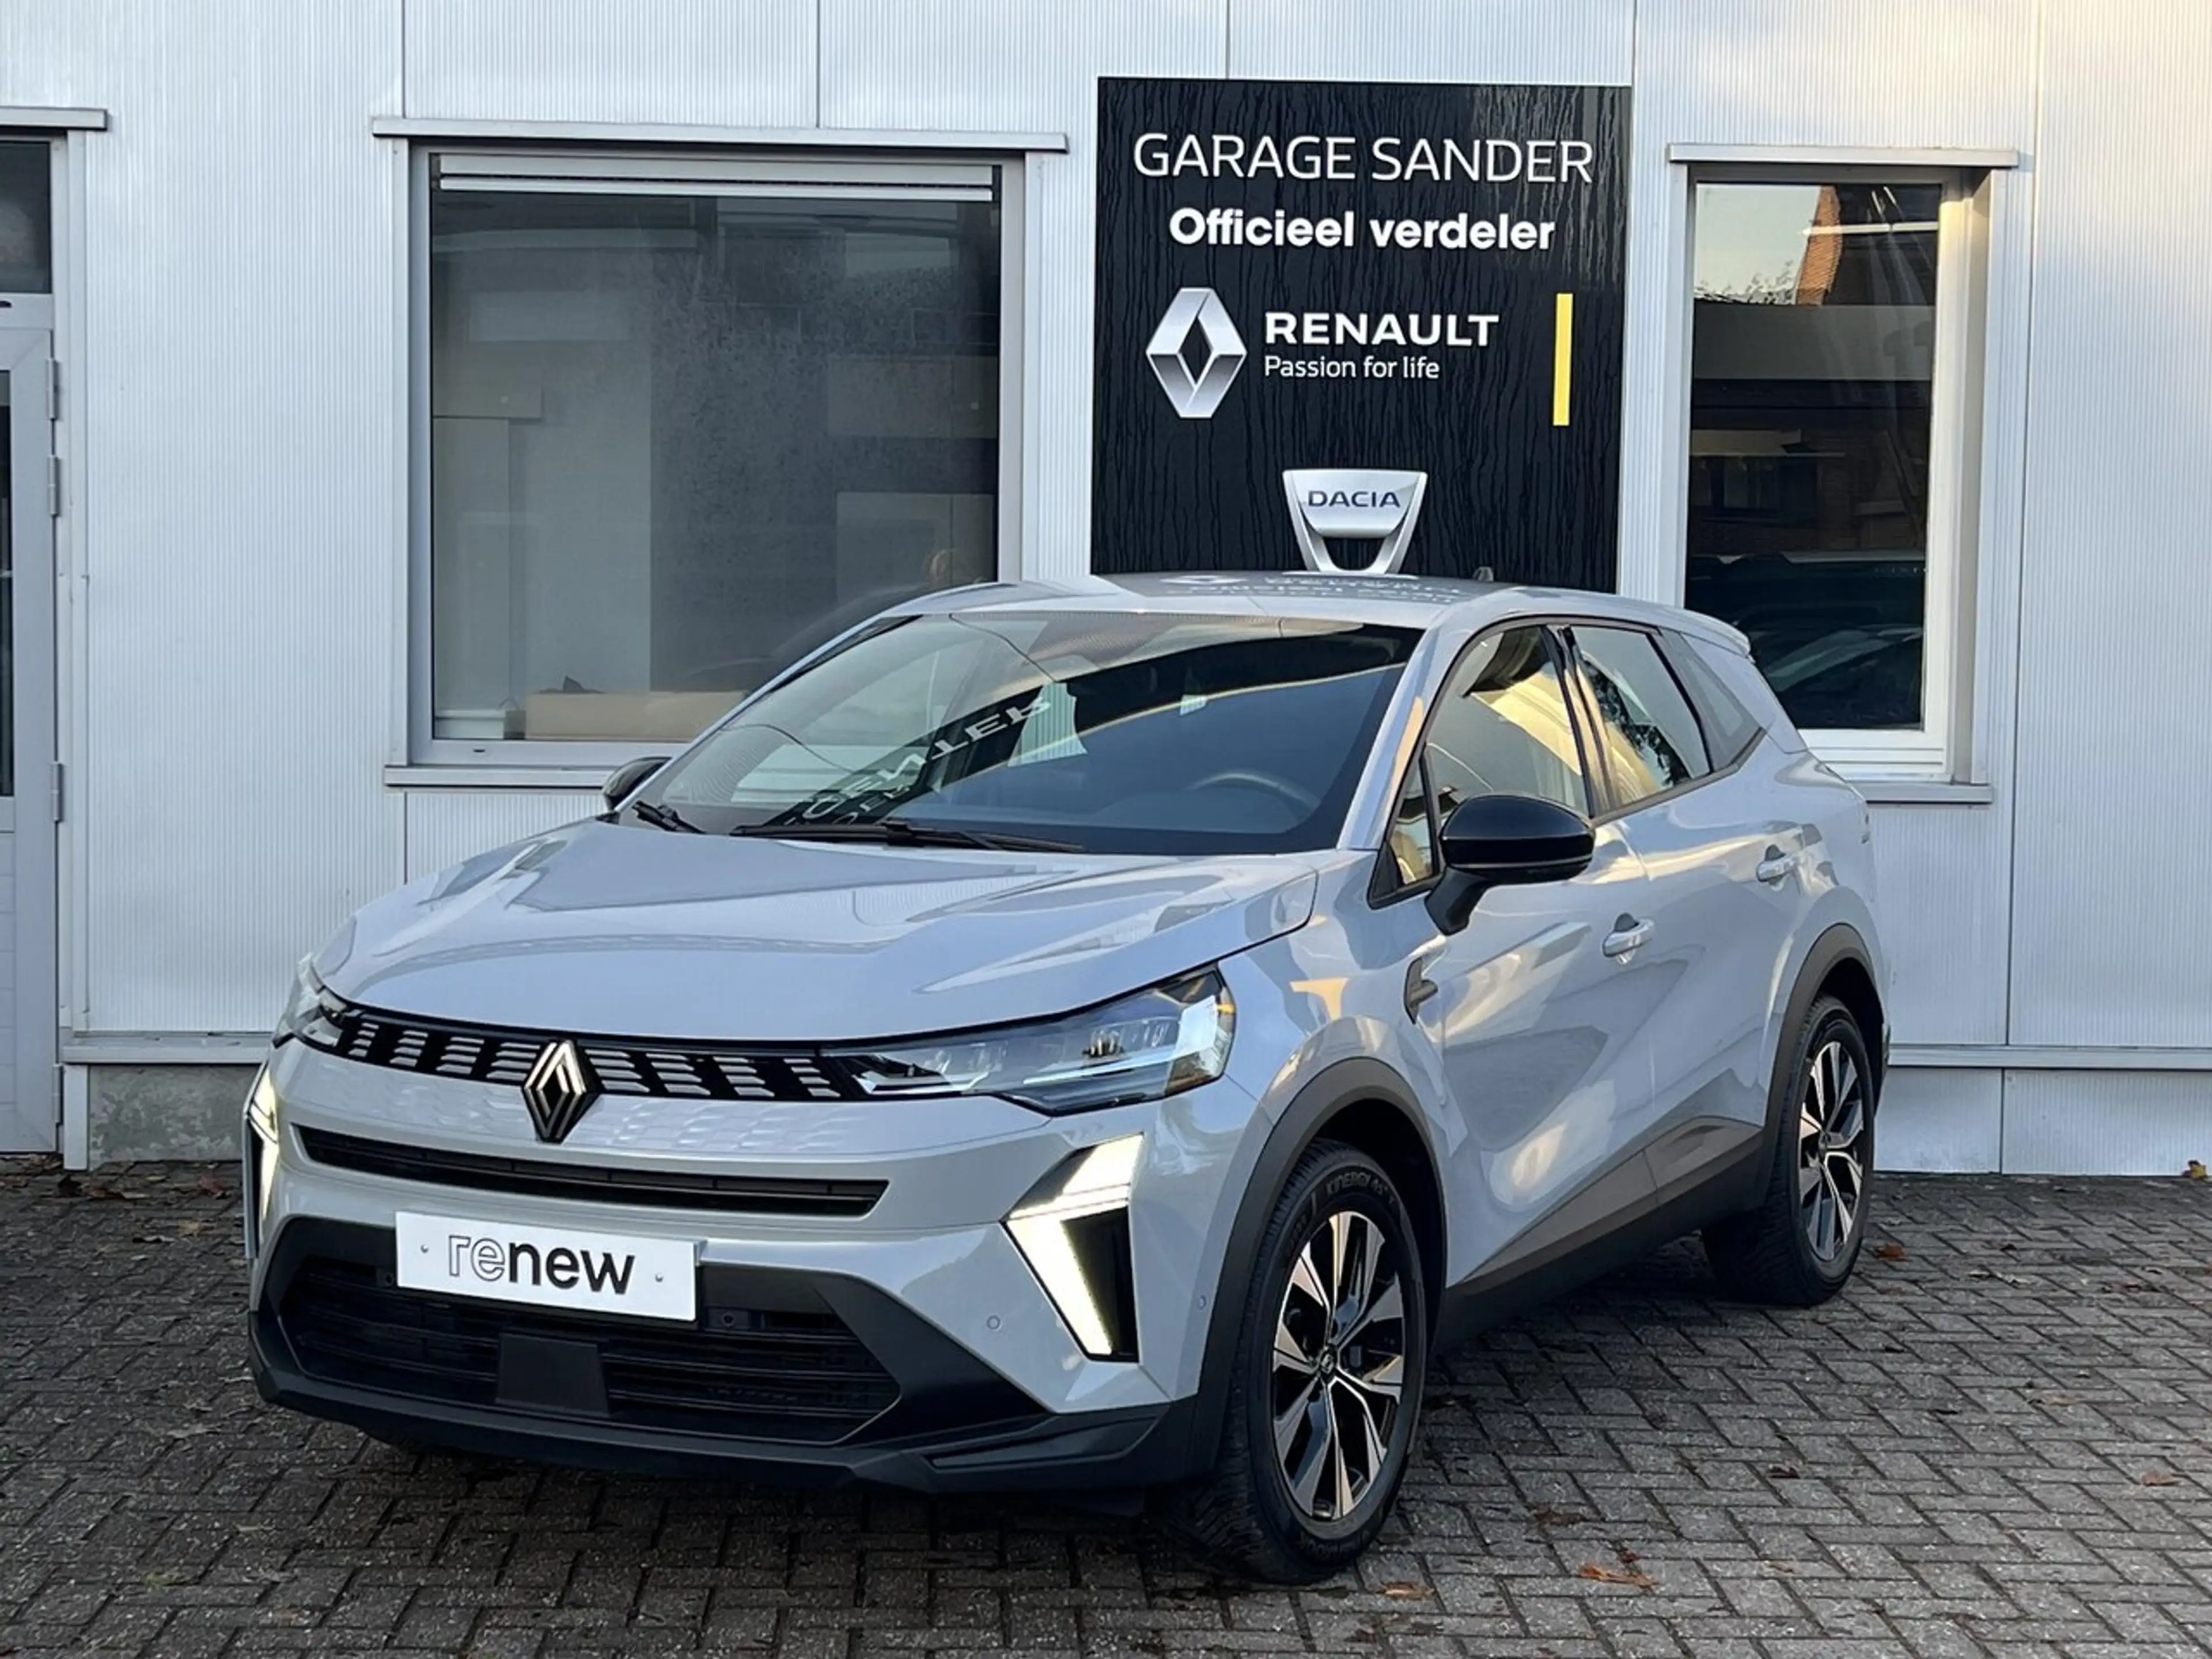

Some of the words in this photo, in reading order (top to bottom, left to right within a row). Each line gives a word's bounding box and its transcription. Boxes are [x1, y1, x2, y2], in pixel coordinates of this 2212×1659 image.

[1134, 132, 1356, 180] GARAGE
[1372, 137, 1593, 183] SANDER
[1169, 207, 1354, 247] Officieel
[1369, 213, 1555, 249] verdeler
[1265, 312, 1499, 346] RENAULT
[1265, 355, 1356, 378] Passion
[1363, 355, 1397, 378] for
[1402, 355, 1440, 379] life
[1308, 490, 1401, 509] DACIA
[448, 1234, 635, 1295] renew
